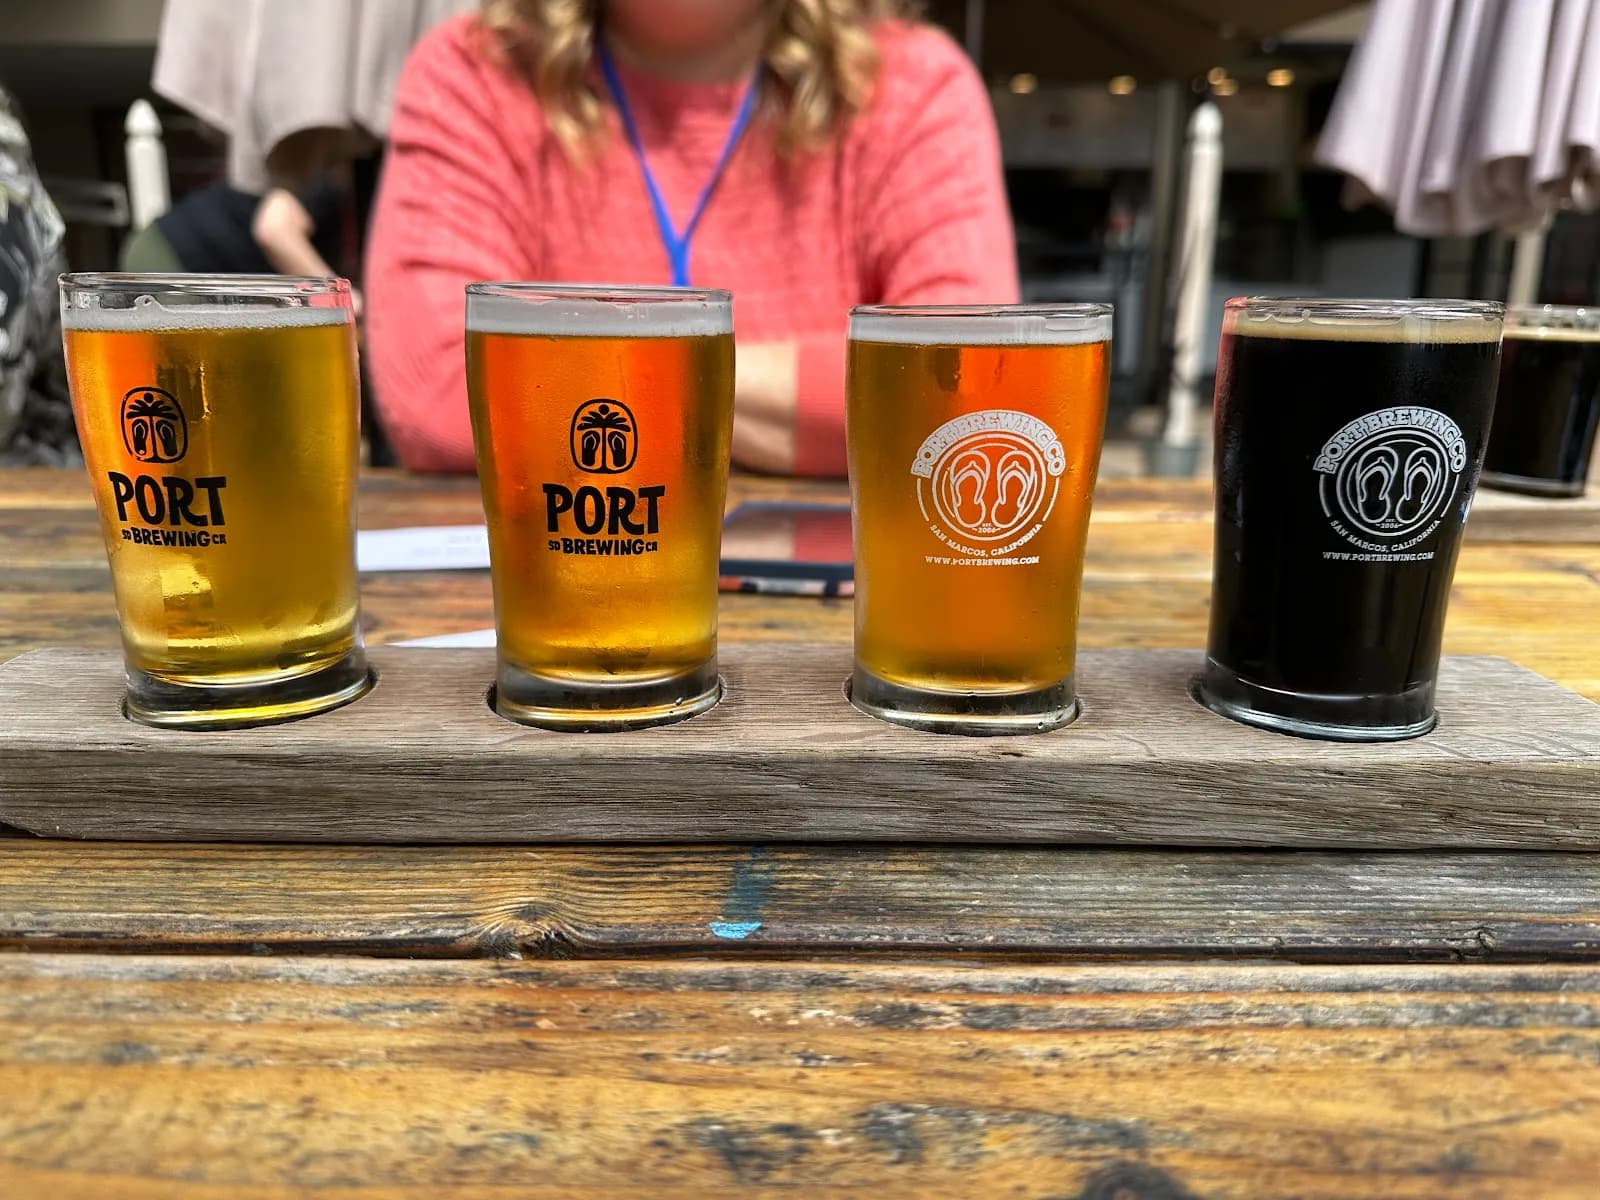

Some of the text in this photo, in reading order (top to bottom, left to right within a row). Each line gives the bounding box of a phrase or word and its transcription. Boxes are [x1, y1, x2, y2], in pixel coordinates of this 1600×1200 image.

[911, 410, 1066, 478] PORT BREWING CO
[1313, 406, 1466, 474] PORT BREWING CO
[108, 471, 227, 527] PORT
[542, 483, 666, 536] PORT
[131, 526, 210, 547] BREWING
[561, 537, 645, 556] BREWING
[930, 523, 1043, 557] SAN MARCOS, CALIFORNIA
[1329, 519, 1441, 553] SAN MARCOS, CALIFORNIA
[925, 555, 1040, 566] WWW.PORTBREWING.COM
[1322, 551, 1435, 562] WWW.PORTBREWING.COM
